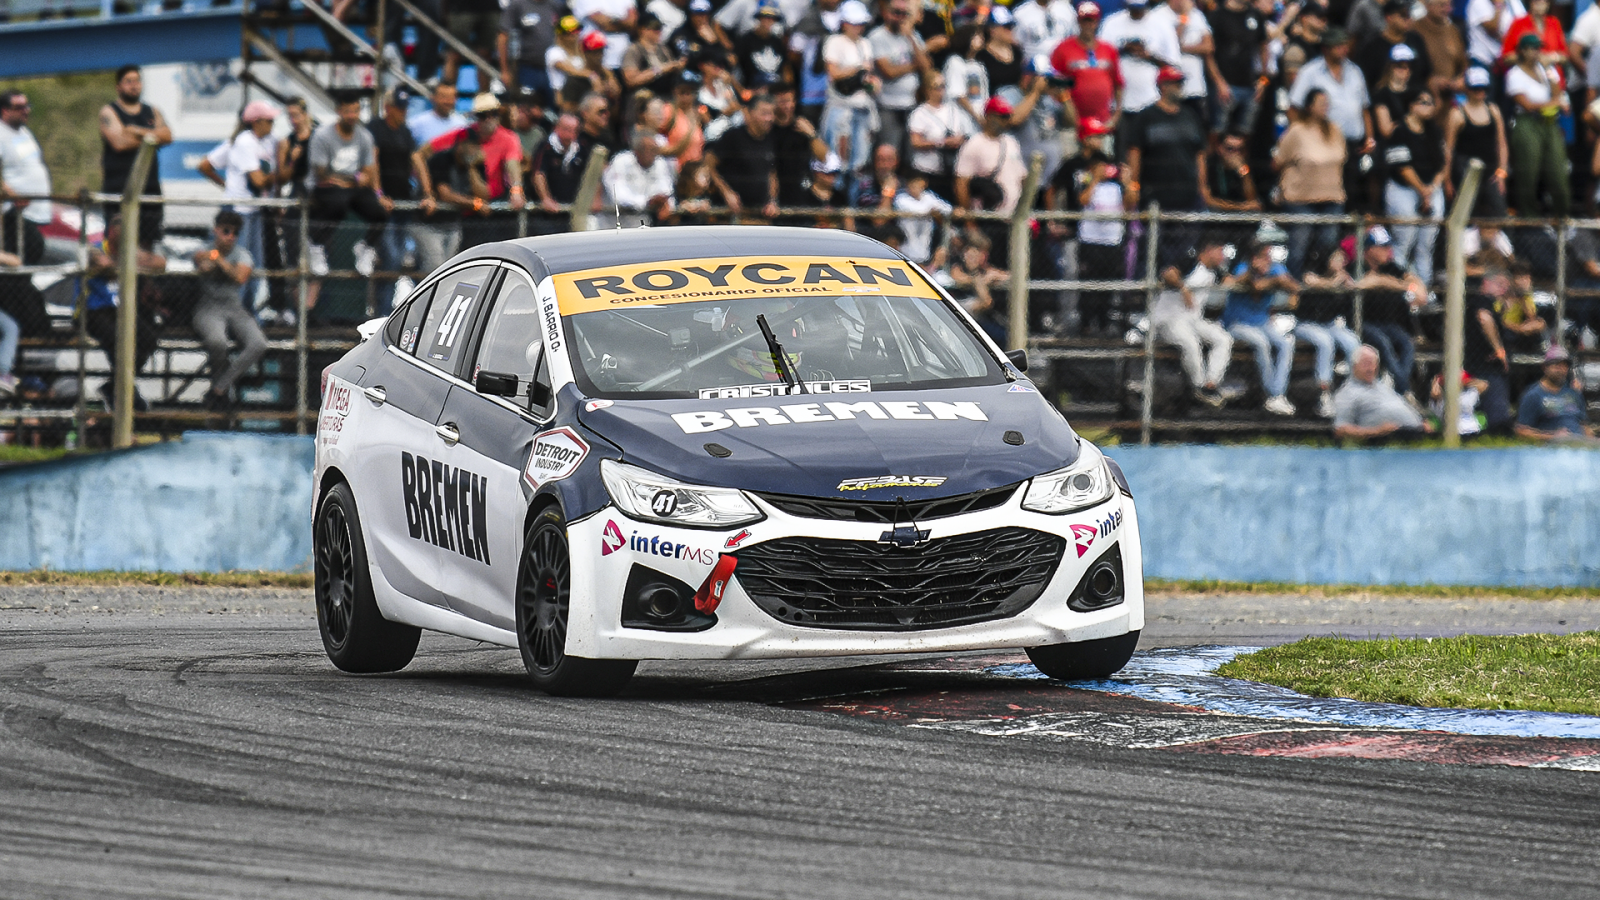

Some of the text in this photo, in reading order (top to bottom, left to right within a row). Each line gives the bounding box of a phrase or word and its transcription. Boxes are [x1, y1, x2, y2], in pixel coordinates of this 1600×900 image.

[573, 263, 914, 299] ROYCAN
[609, 286, 833, 304] CONCESIONARIO OFICIAL
[437, 294, 472, 348] 41
[671, 401, 989, 435] BREMEN
[535, 441, 581, 464] DETROIT
[535, 457, 566, 472] INDUSTRY
[401, 450, 491, 566] BREMEN
[652, 494, 676, 513] 41
[630, 530, 714, 566] interMS
